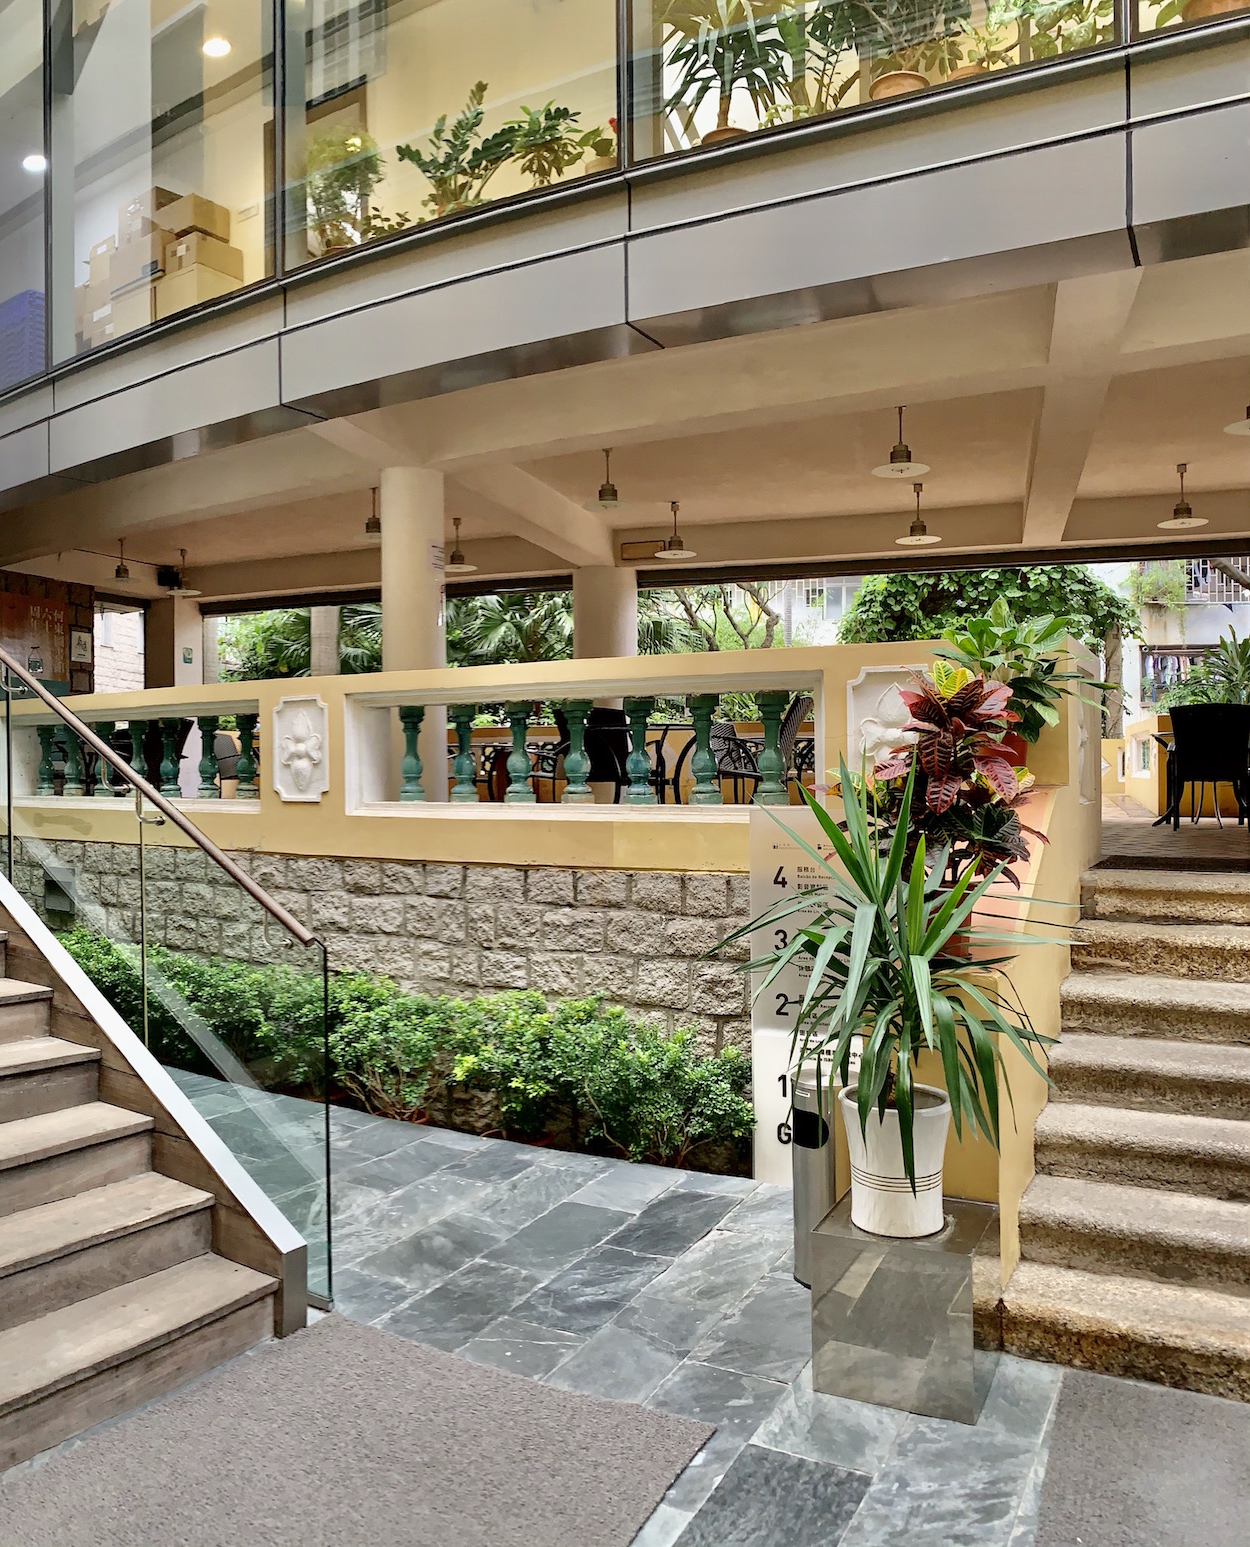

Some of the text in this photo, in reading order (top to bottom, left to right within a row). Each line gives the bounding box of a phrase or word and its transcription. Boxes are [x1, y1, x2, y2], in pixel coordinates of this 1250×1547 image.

[773, 866, 788, 888] 4
[774, 929, 788, 951] 3
[775, 993, 789, 1016] 2
[778, 1074, 787, 1097] 1
[777, 1122, 792, 1144] G
